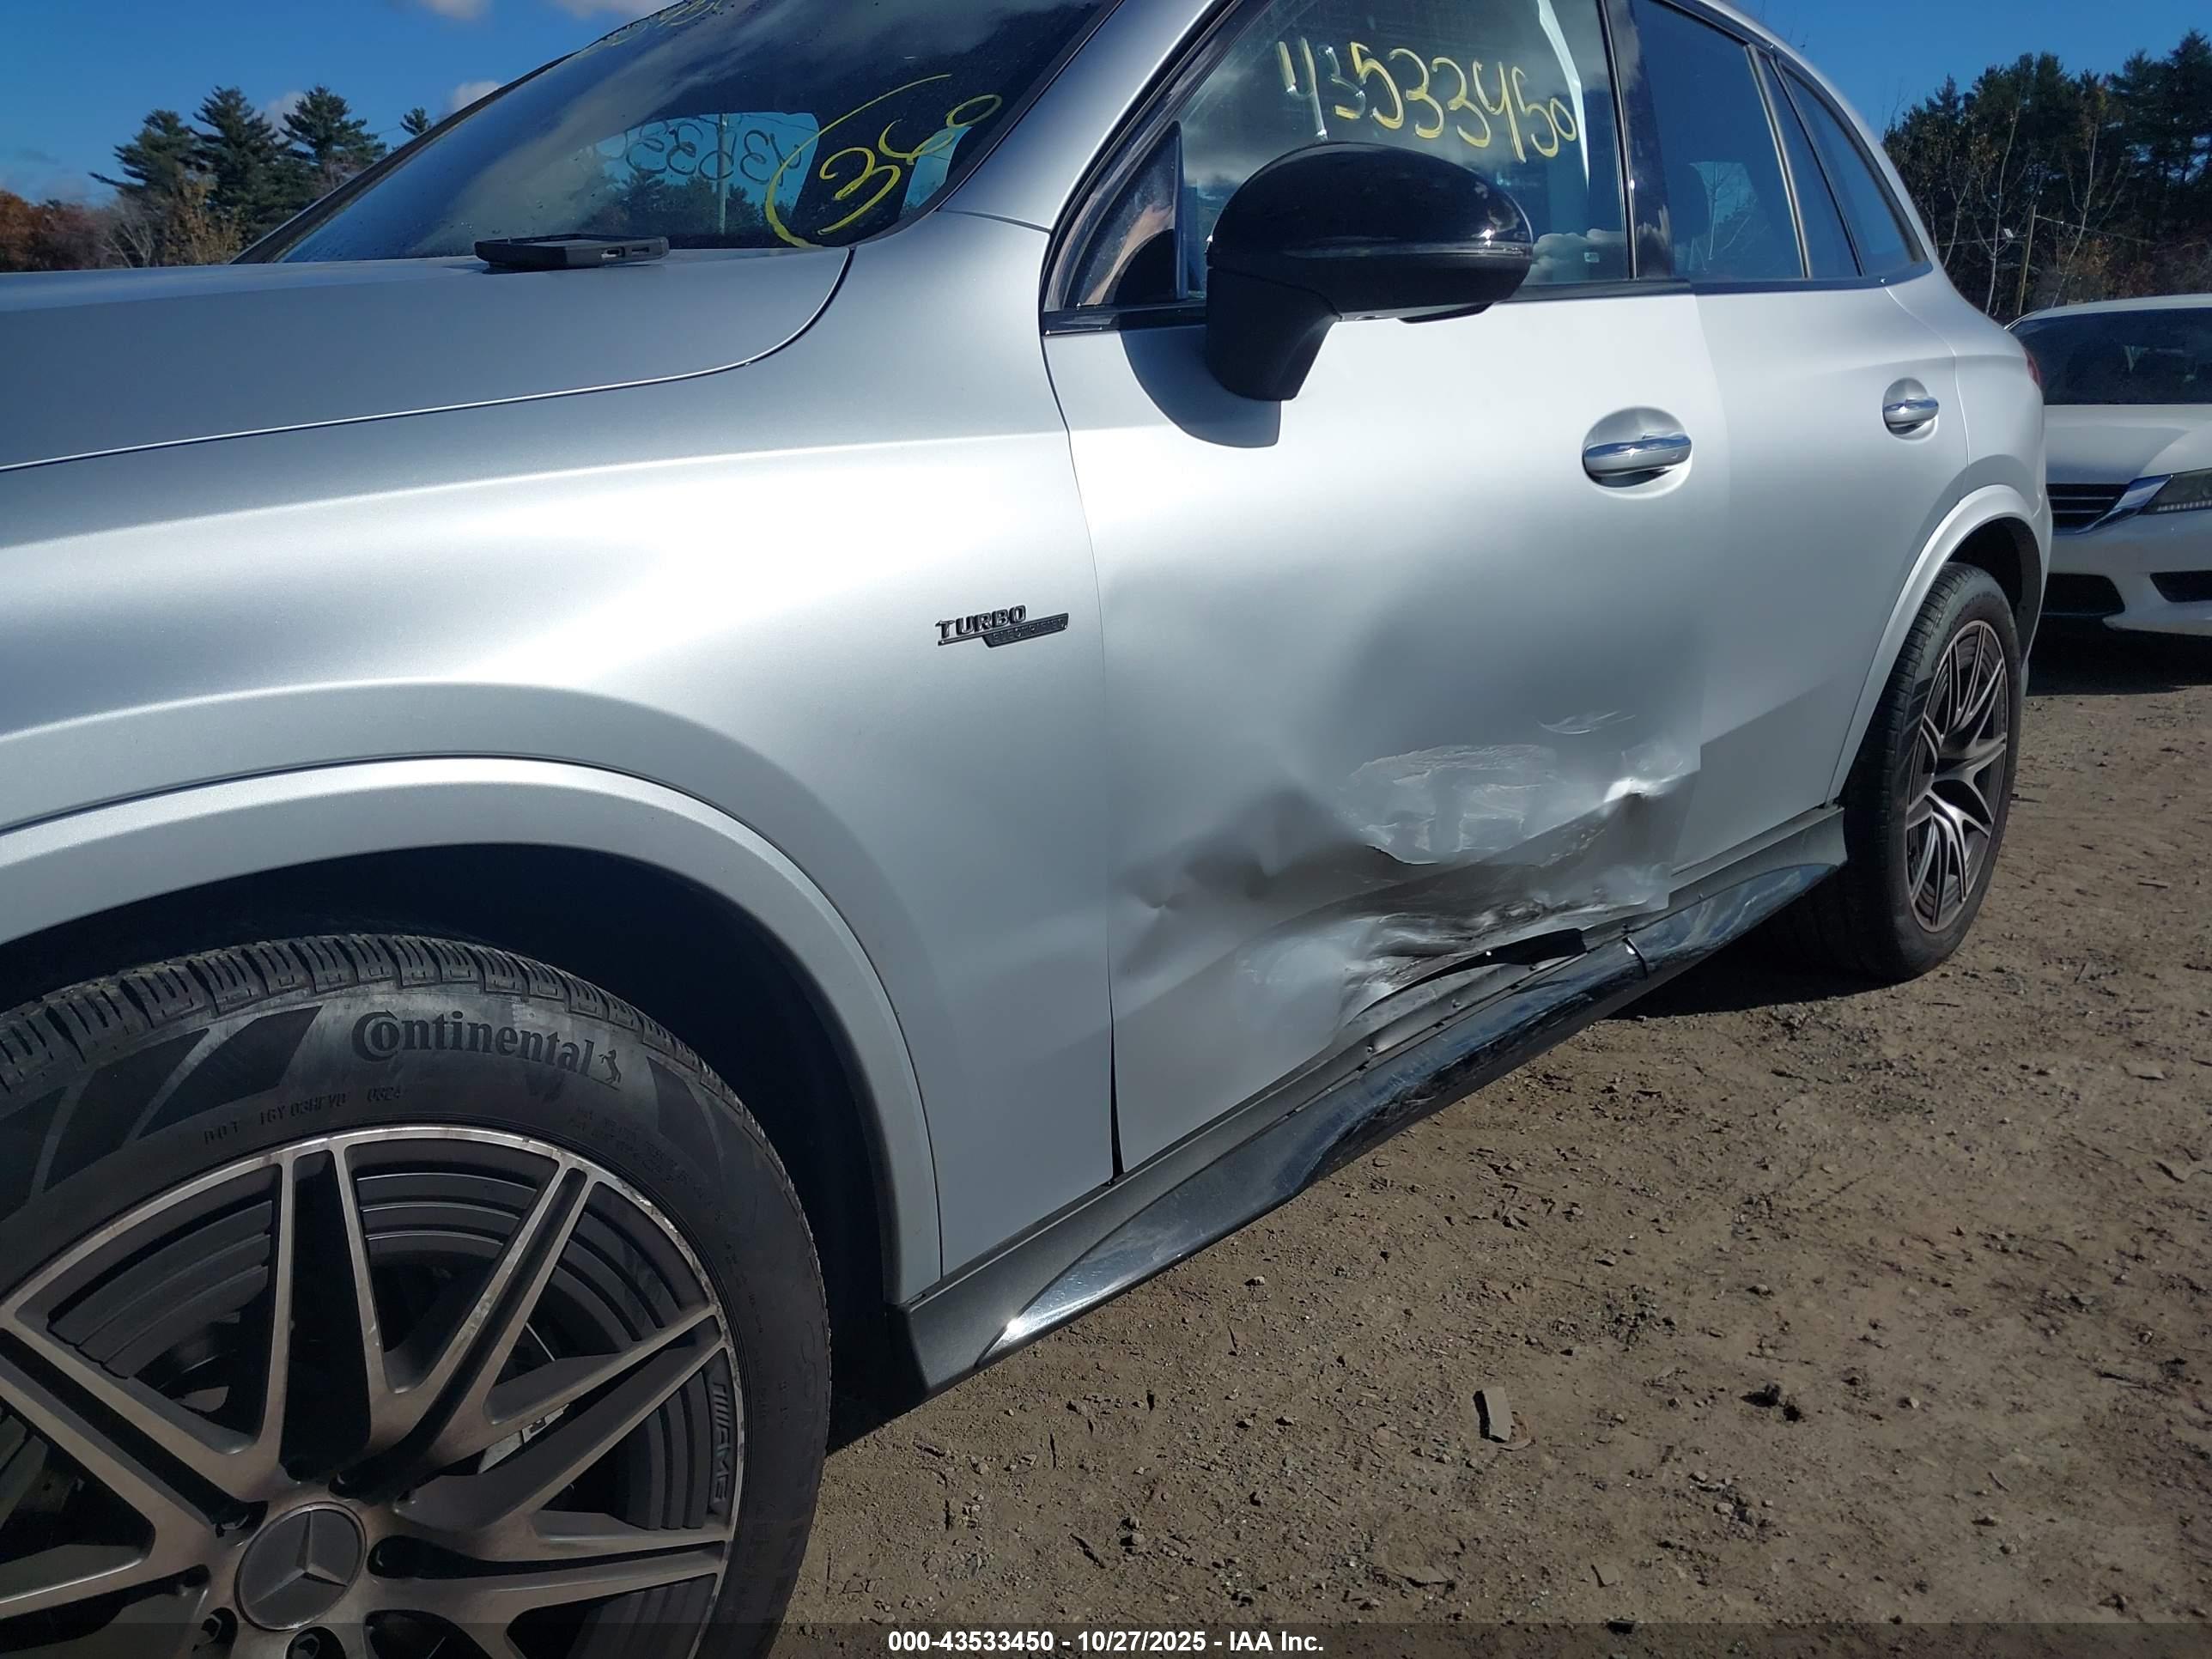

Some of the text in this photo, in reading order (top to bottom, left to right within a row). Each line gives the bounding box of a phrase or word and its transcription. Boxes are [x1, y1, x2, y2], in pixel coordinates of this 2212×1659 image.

[1275, 36, 1578, 164] 43533450
[934, 605, 1027, 639] TURBO
[351, 1010, 594, 1074] Continental
